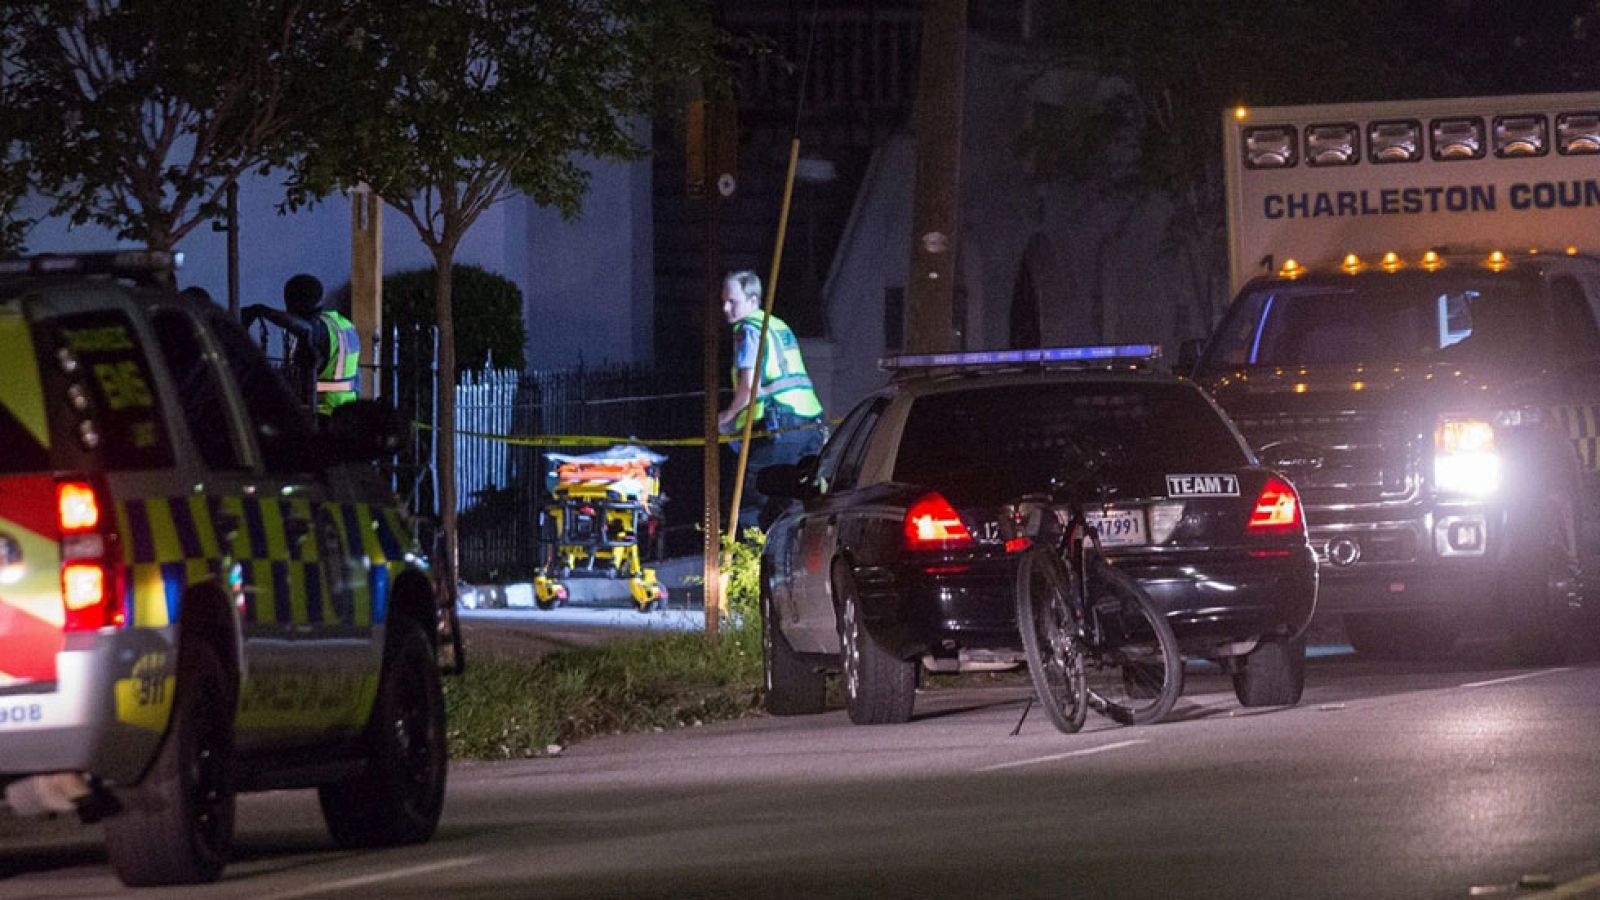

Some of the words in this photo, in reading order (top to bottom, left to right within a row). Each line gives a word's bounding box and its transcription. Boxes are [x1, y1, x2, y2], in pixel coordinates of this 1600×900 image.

[1263, 186, 1496, 220] CHARLESTON
[1170, 476, 1222, 494] TEAM
[1223, 476, 1234, 493] 7
